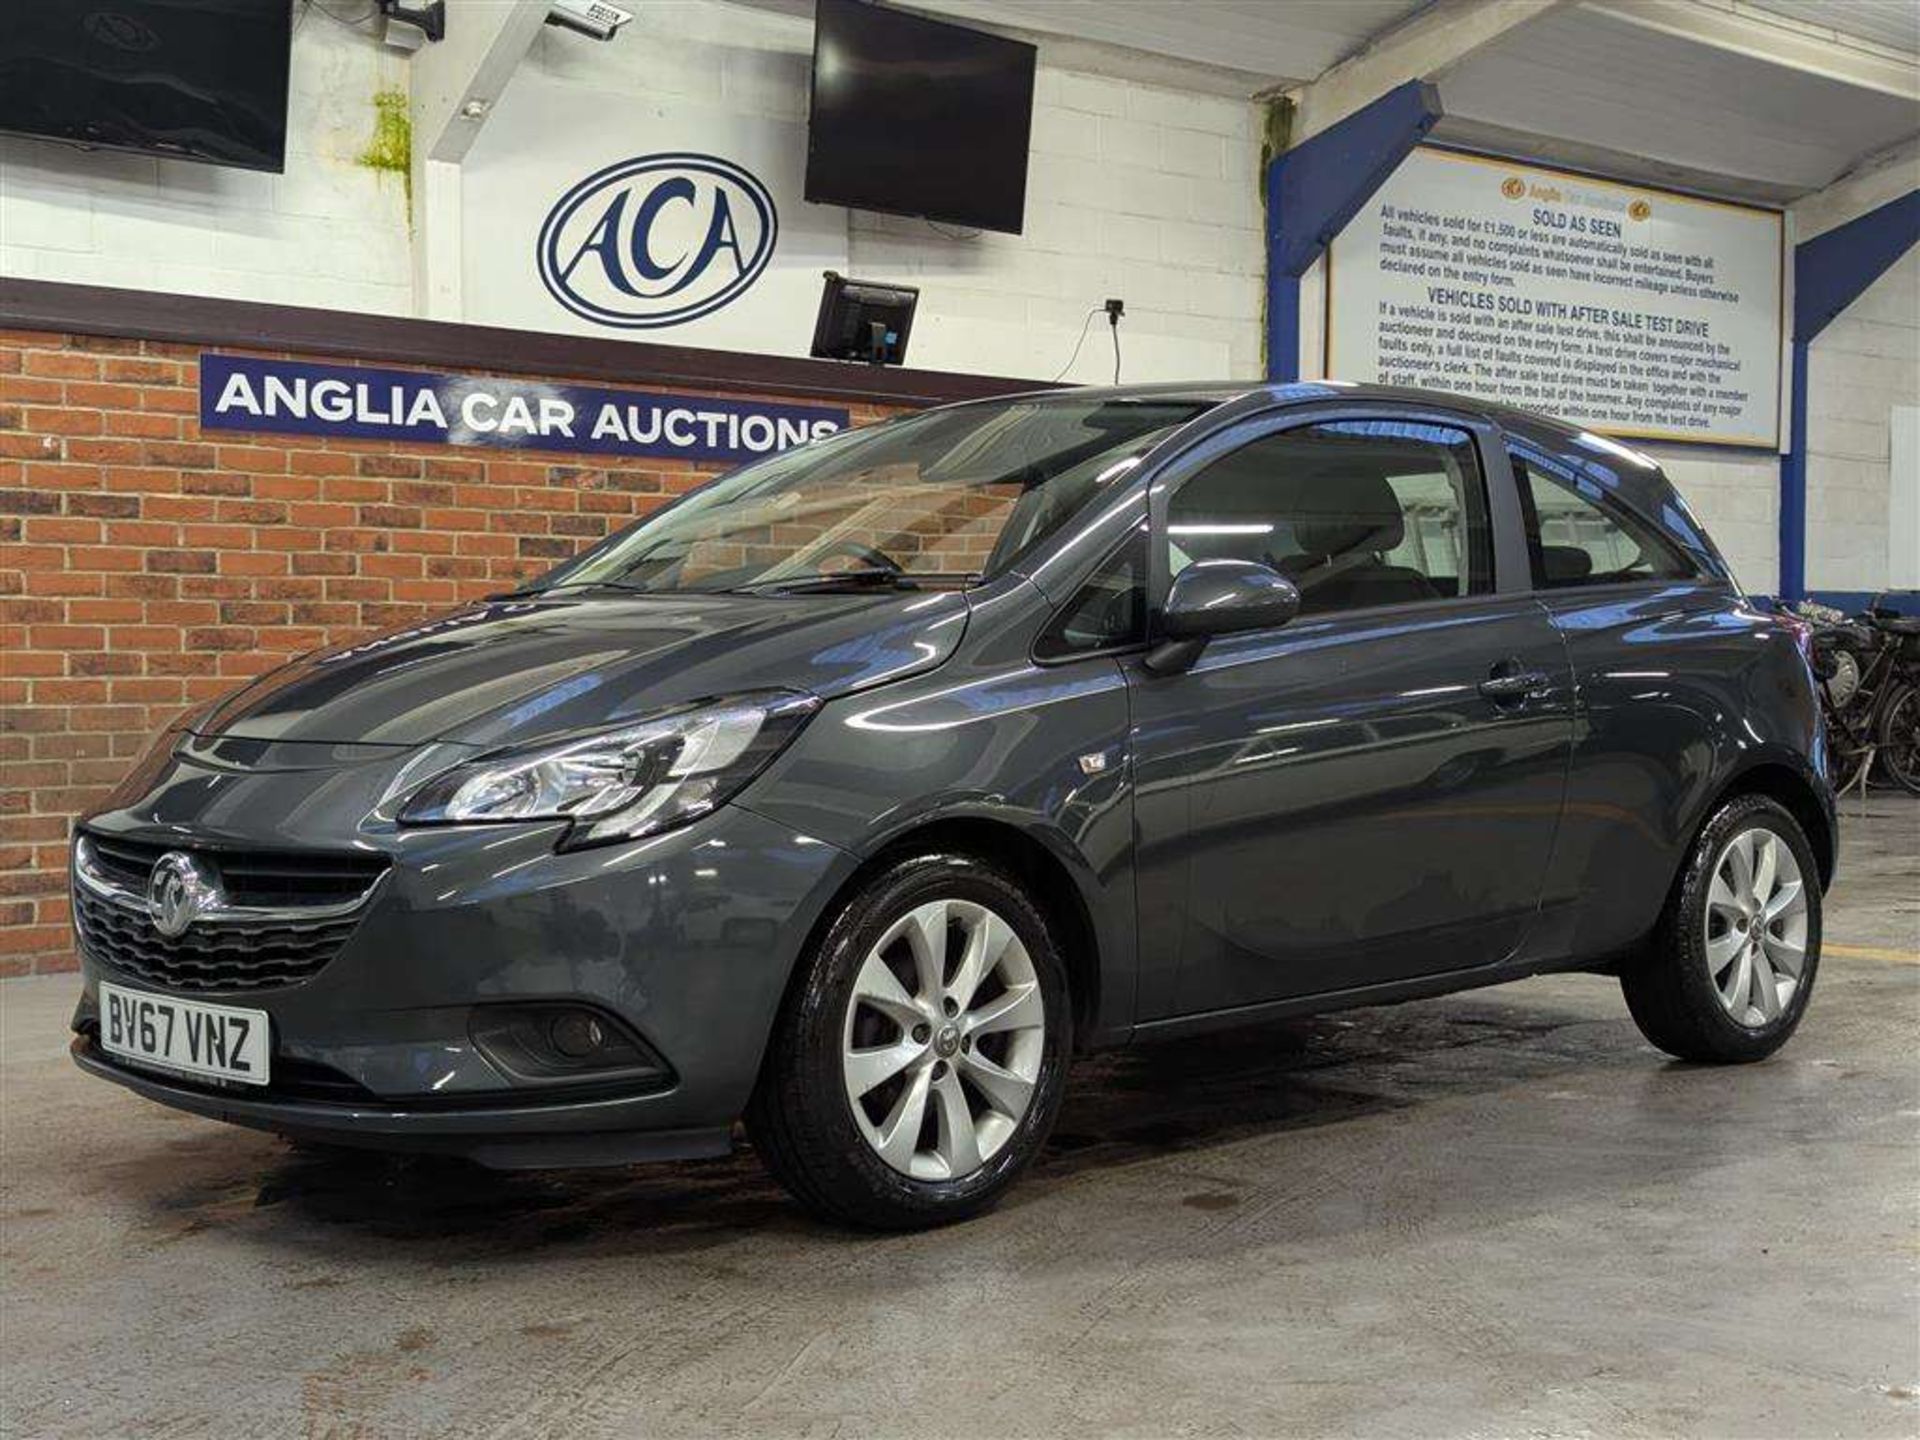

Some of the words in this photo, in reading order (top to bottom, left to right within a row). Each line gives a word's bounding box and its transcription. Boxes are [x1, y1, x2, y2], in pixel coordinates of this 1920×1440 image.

[559, 176, 748, 299] ACA
[1381, 204, 1394, 218] All
[1397, 206, 1439, 225] vehicles
[1442, 214, 1464, 229] sold
[1465, 218, 1481, 232] for
[1551, 235, 1566, 246] are
[1629, 244, 1648, 259] sold
[1662, 253, 1682, 264] seen
[1684, 253, 1702, 267] with
[1703, 256, 1713, 269] all
[1533, 208, 1567, 229] SOLD
[1569, 214, 1585, 232] AS
[1589, 218, 1621, 238] SEEN
[1379, 239, 1407, 254] must
[1408, 246, 1448, 261] assume
[1451, 250, 1463, 263] all
[1465, 252, 1507, 269] vehicles
[1509, 259, 1530, 273] sold
[1545, 267, 1567, 278] seen
[1569, 268, 1590, 281] have
[1593, 271, 1633, 288] incorrect
[1669, 283, 1697, 297] unless
[1379, 256, 1425, 275] declared
[1443, 266, 1460, 280] the
[1462, 268, 1487, 287] entry
[1451, 233, 1470, 247] and
[1488, 239, 1539, 261] complaints
[1596, 256, 1617, 269] shall
[1685, 270, 1713, 287] Buyers
[1398, 304, 1435, 320] vehicle
[1449, 310, 1471, 324] sold
[1473, 313, 1495, 327] with
[1510, 318, 1532, 332] after
[1534, 321, 1554, 335] sale
[1555, 324, 1574, 337] test
[1603, 330, 1622, 343] this
[1622, 332, 1644, 346] shall
[1717, 344, 1729, 356] the
[1427, 285, 1494, 310] VEHICLES
[1497, 295, 1531, 315] SOLD
[1535, 300, 1566, 320] WITH
[1570, 305, 1609, 325] AFTER
[1611, 310, 1642, 330] SALE
[1645, 315, 1673, 334] TEST
[1675, 319, 1709, 338] DRIVE
[1378, 319, 1433, 336] auctioneer
[1435, 326, 1455, 339] and
[1457, 329, 1501, 344] declared
[1517, 336, 1532, 348] the
[1534, 338, 1558, 354] entry
[1595, 346, 1613, 357] test
[1615, 348, 1637, 360] drive
[1638, 352, 1667, 364] covers
[1670, 356, 1693, 370] major
[1378, 336, 1408, 351] faults
[1446, 344, 1462, 357] full
[1465, 346, 1480, 359] list
[1496, 350, 1521, 363] faults
[1524, 353, 1560, 368] covered
[1573, 359, 1617, 377] displayed
[1628, 365, 1643, 377] the
[1645, 367, 1669, 380] office
[1671, 370, 1687, 382] and
[1689, 372, 1706, 384] with
[1707, 374, 1721, 386] the
[1378, 353, 1440, 371] auctioneer's
[1474, 364, 1492, 377] The
[1495, 366, 1517, 379] after
[1519, 368, 1539, 382] sale
[1540, 371, 1559, 384] test
[1560, 373, 1583, 386] drive
[1585, 376, 1608, 389] must
[1652, 383, 1687, 400] together
[1689, 387, 1706, 399] with
[1420, 375, 1452, 389] within
[1453, 381, 1471, 391] one
[1474, 381, 1497, 394] hour
[1499, 383, 1522, 396] from
[1524, 386, 1539, 398] the
[1540, 387, 1556, 400] fall
[1568, 390, 1584, 402] the
[1625, 396, 1644, 410] Any
[1643, 398, 1691, 415] complaints
[1702, 406, 1717, 418] any
[1718, 408, 1742, 420] major
[215, 373, 448, 429] ANGLIA
[461, 393, 575, 438] CAR
[1562, 404, 1588, 417] within
[1591, 409, 1608, 419] one
[1609, 408, 1631, 421] hour
[1632, 411, 1652, 423] from
[1654, 413, 1669, 425] the
[1670, 414, 1686, 426] test
[108, 993, 175, 1057] BV67
[185, 1010, 251, 1072] VNZ
